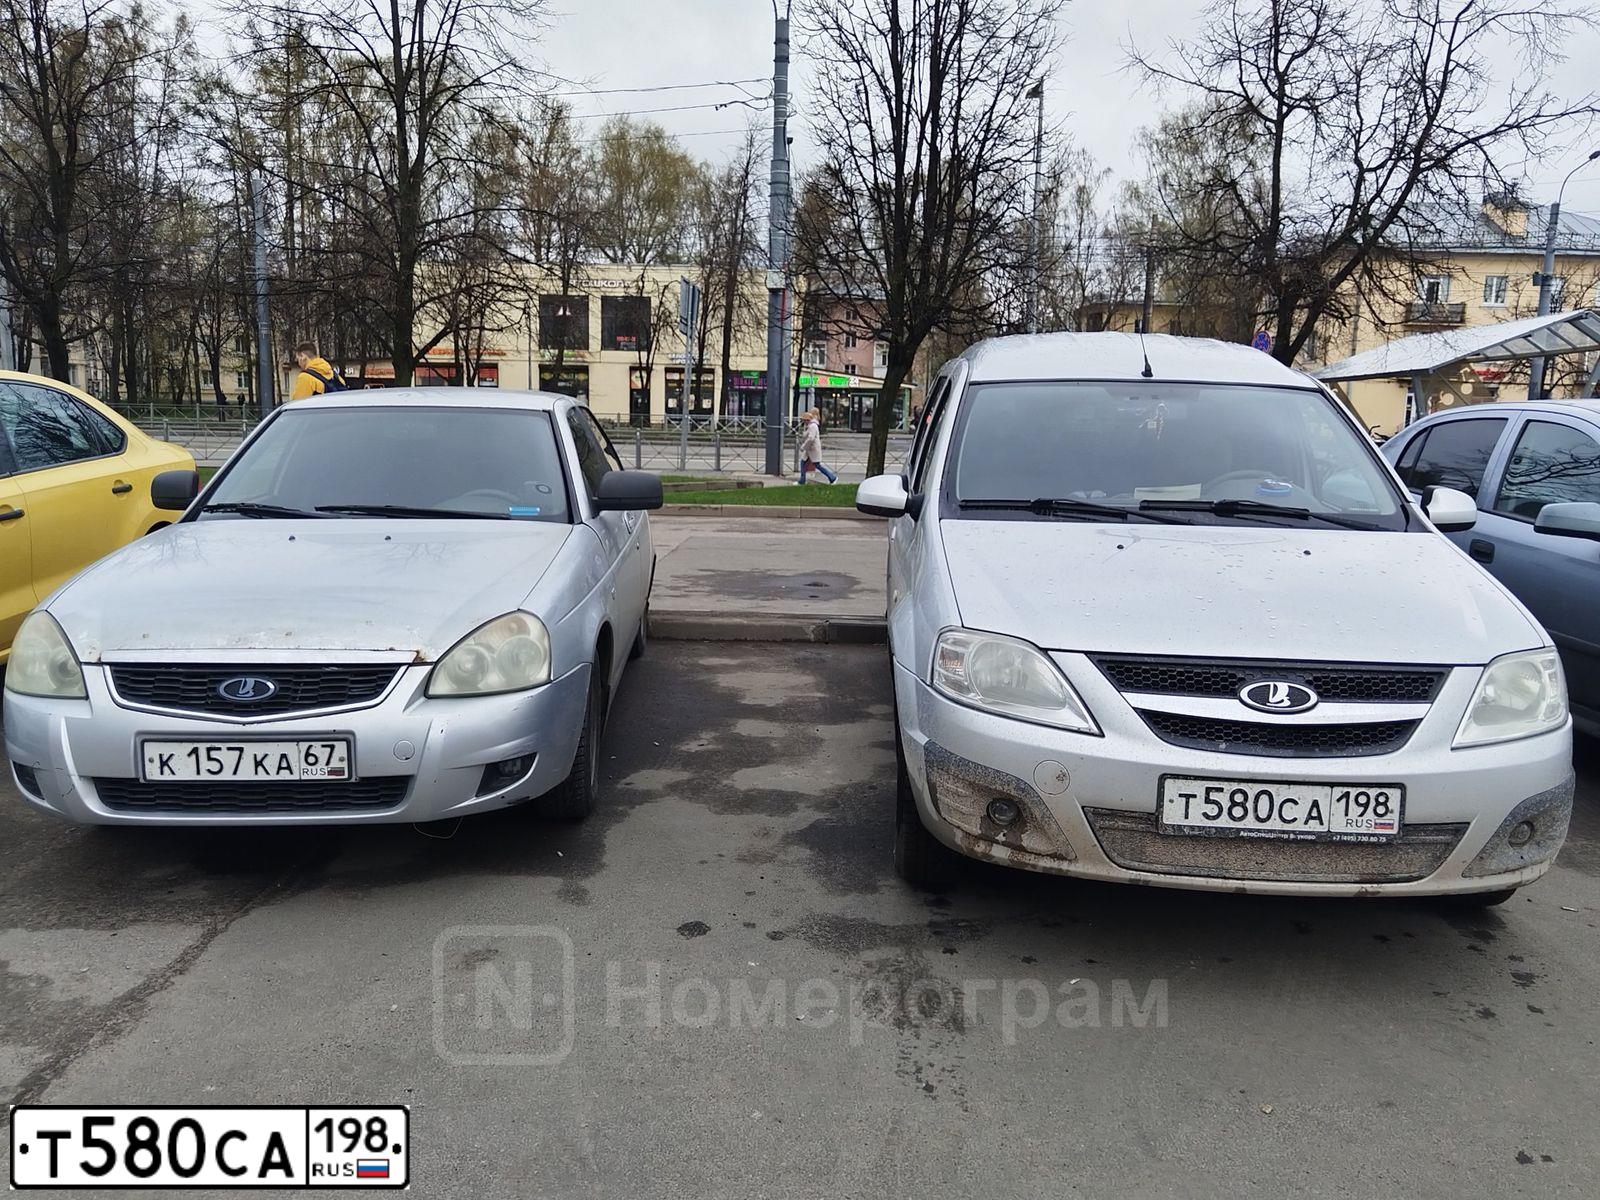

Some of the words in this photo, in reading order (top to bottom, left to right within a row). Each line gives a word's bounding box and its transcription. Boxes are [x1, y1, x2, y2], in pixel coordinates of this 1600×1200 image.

[304, 744, 336, 767] 67
[302, 767, 327, 776] RUS
[1178, 786, 1324, 827] Т580СА
[1335, 791, 1390, 818] 198
[1345, 818, 1373, 829] RUS
[1289, 832, 1316, 841] Вуково
